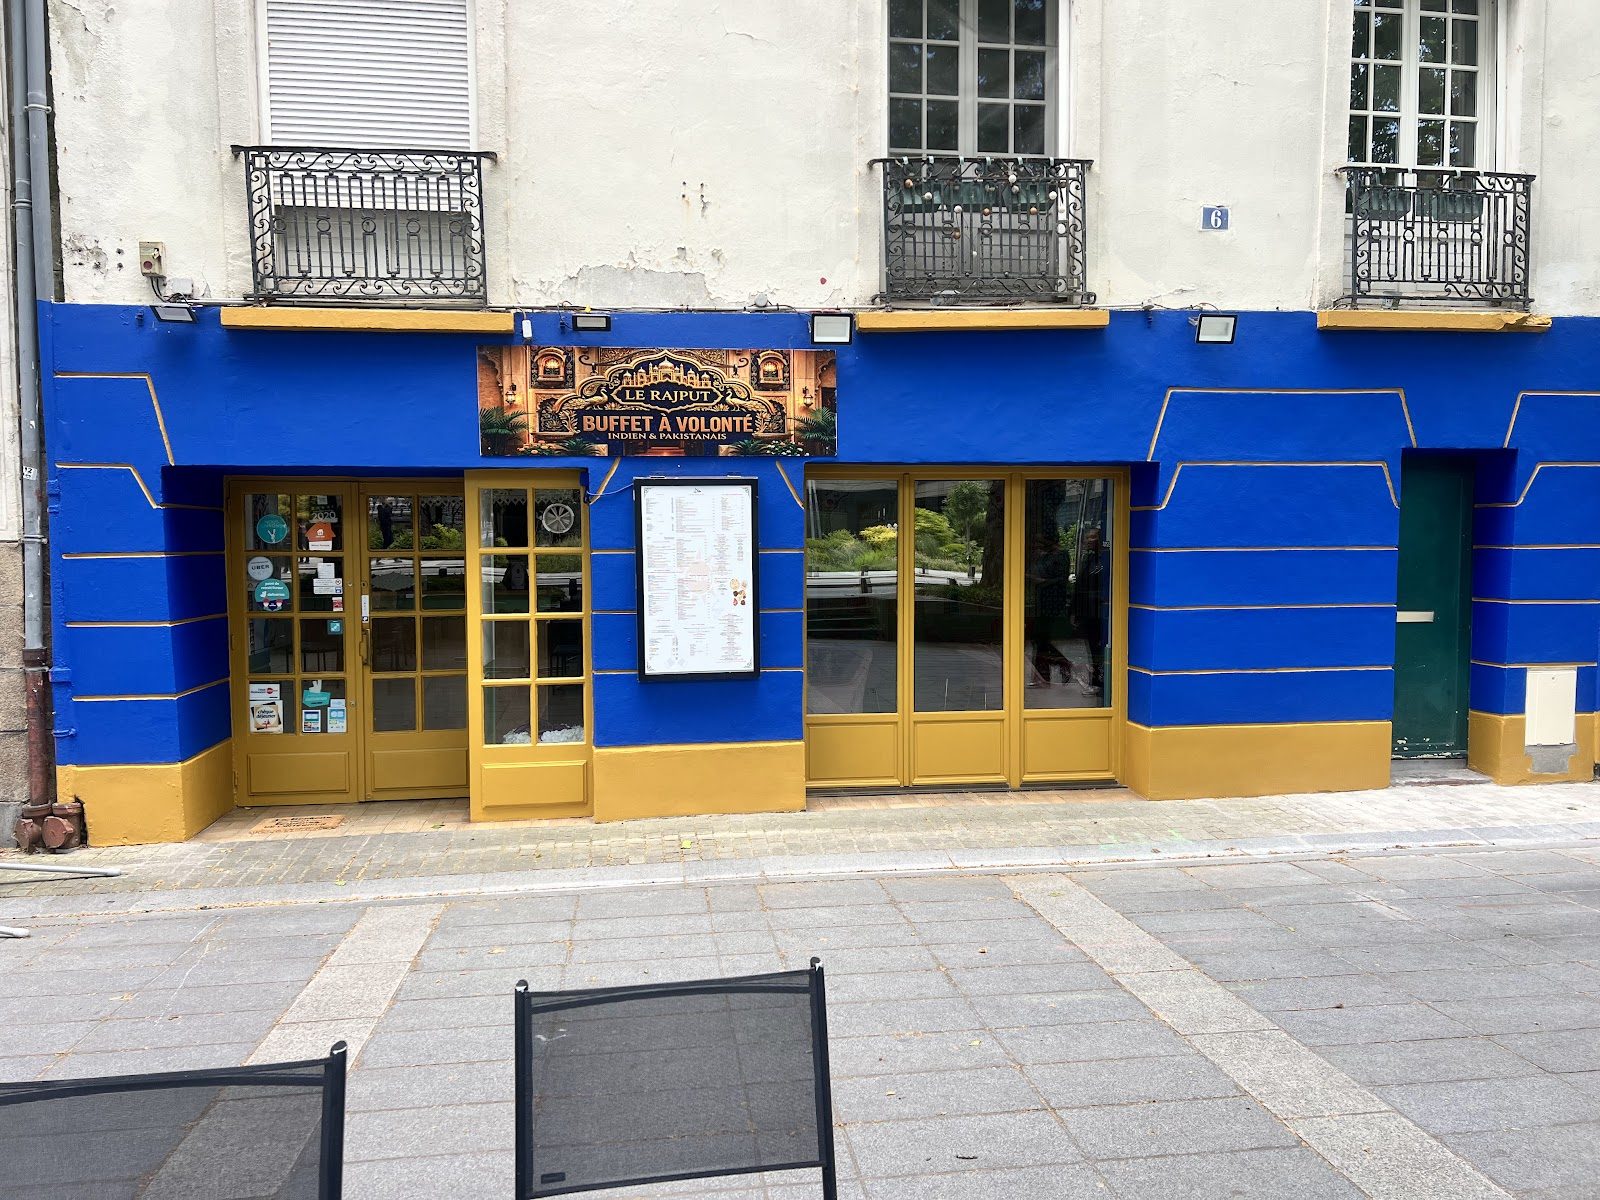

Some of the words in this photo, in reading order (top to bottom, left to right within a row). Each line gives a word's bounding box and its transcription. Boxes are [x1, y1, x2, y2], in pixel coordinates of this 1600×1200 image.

[1210, 209, 1223, 230] 6
[625, 389, 645, 400] LE
[652, 389, 711, 403] RAJPUT
[582, 415, 654, 432] BUFFET
[658, 413, 672, 432] À
[675, 414, 753, 432] VOLONTÉ
[607, 432, 647, 440] INDIEN
[648, 432, 658, 440] &
[659, 432, 727, 440] PAKISTANAIS
[311, 511, 336, 521] 2020
